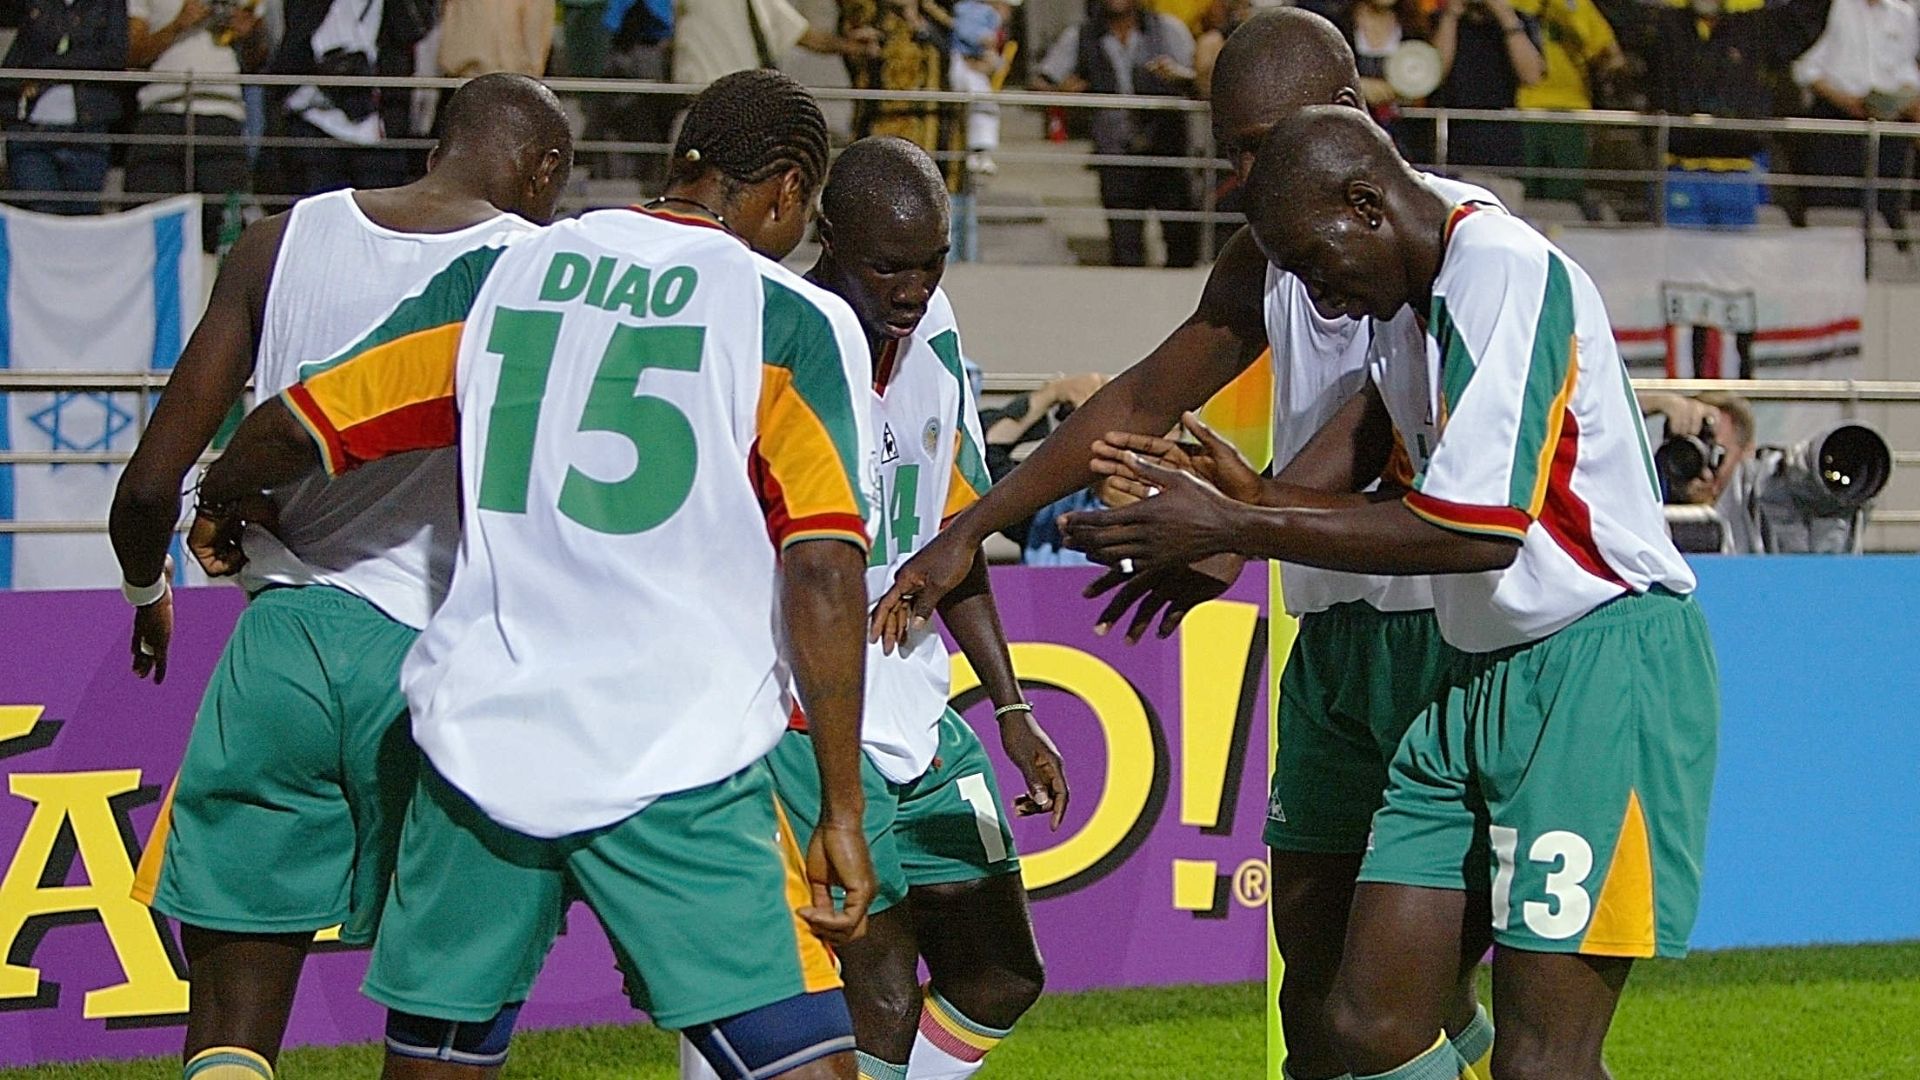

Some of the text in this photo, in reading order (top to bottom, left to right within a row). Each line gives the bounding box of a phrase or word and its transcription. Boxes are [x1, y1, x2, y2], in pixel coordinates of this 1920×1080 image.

[538, 252, 699, 318] DIAO
[477, 305, 707, 535] 15
[1489, 824, 1594, 940] 13
